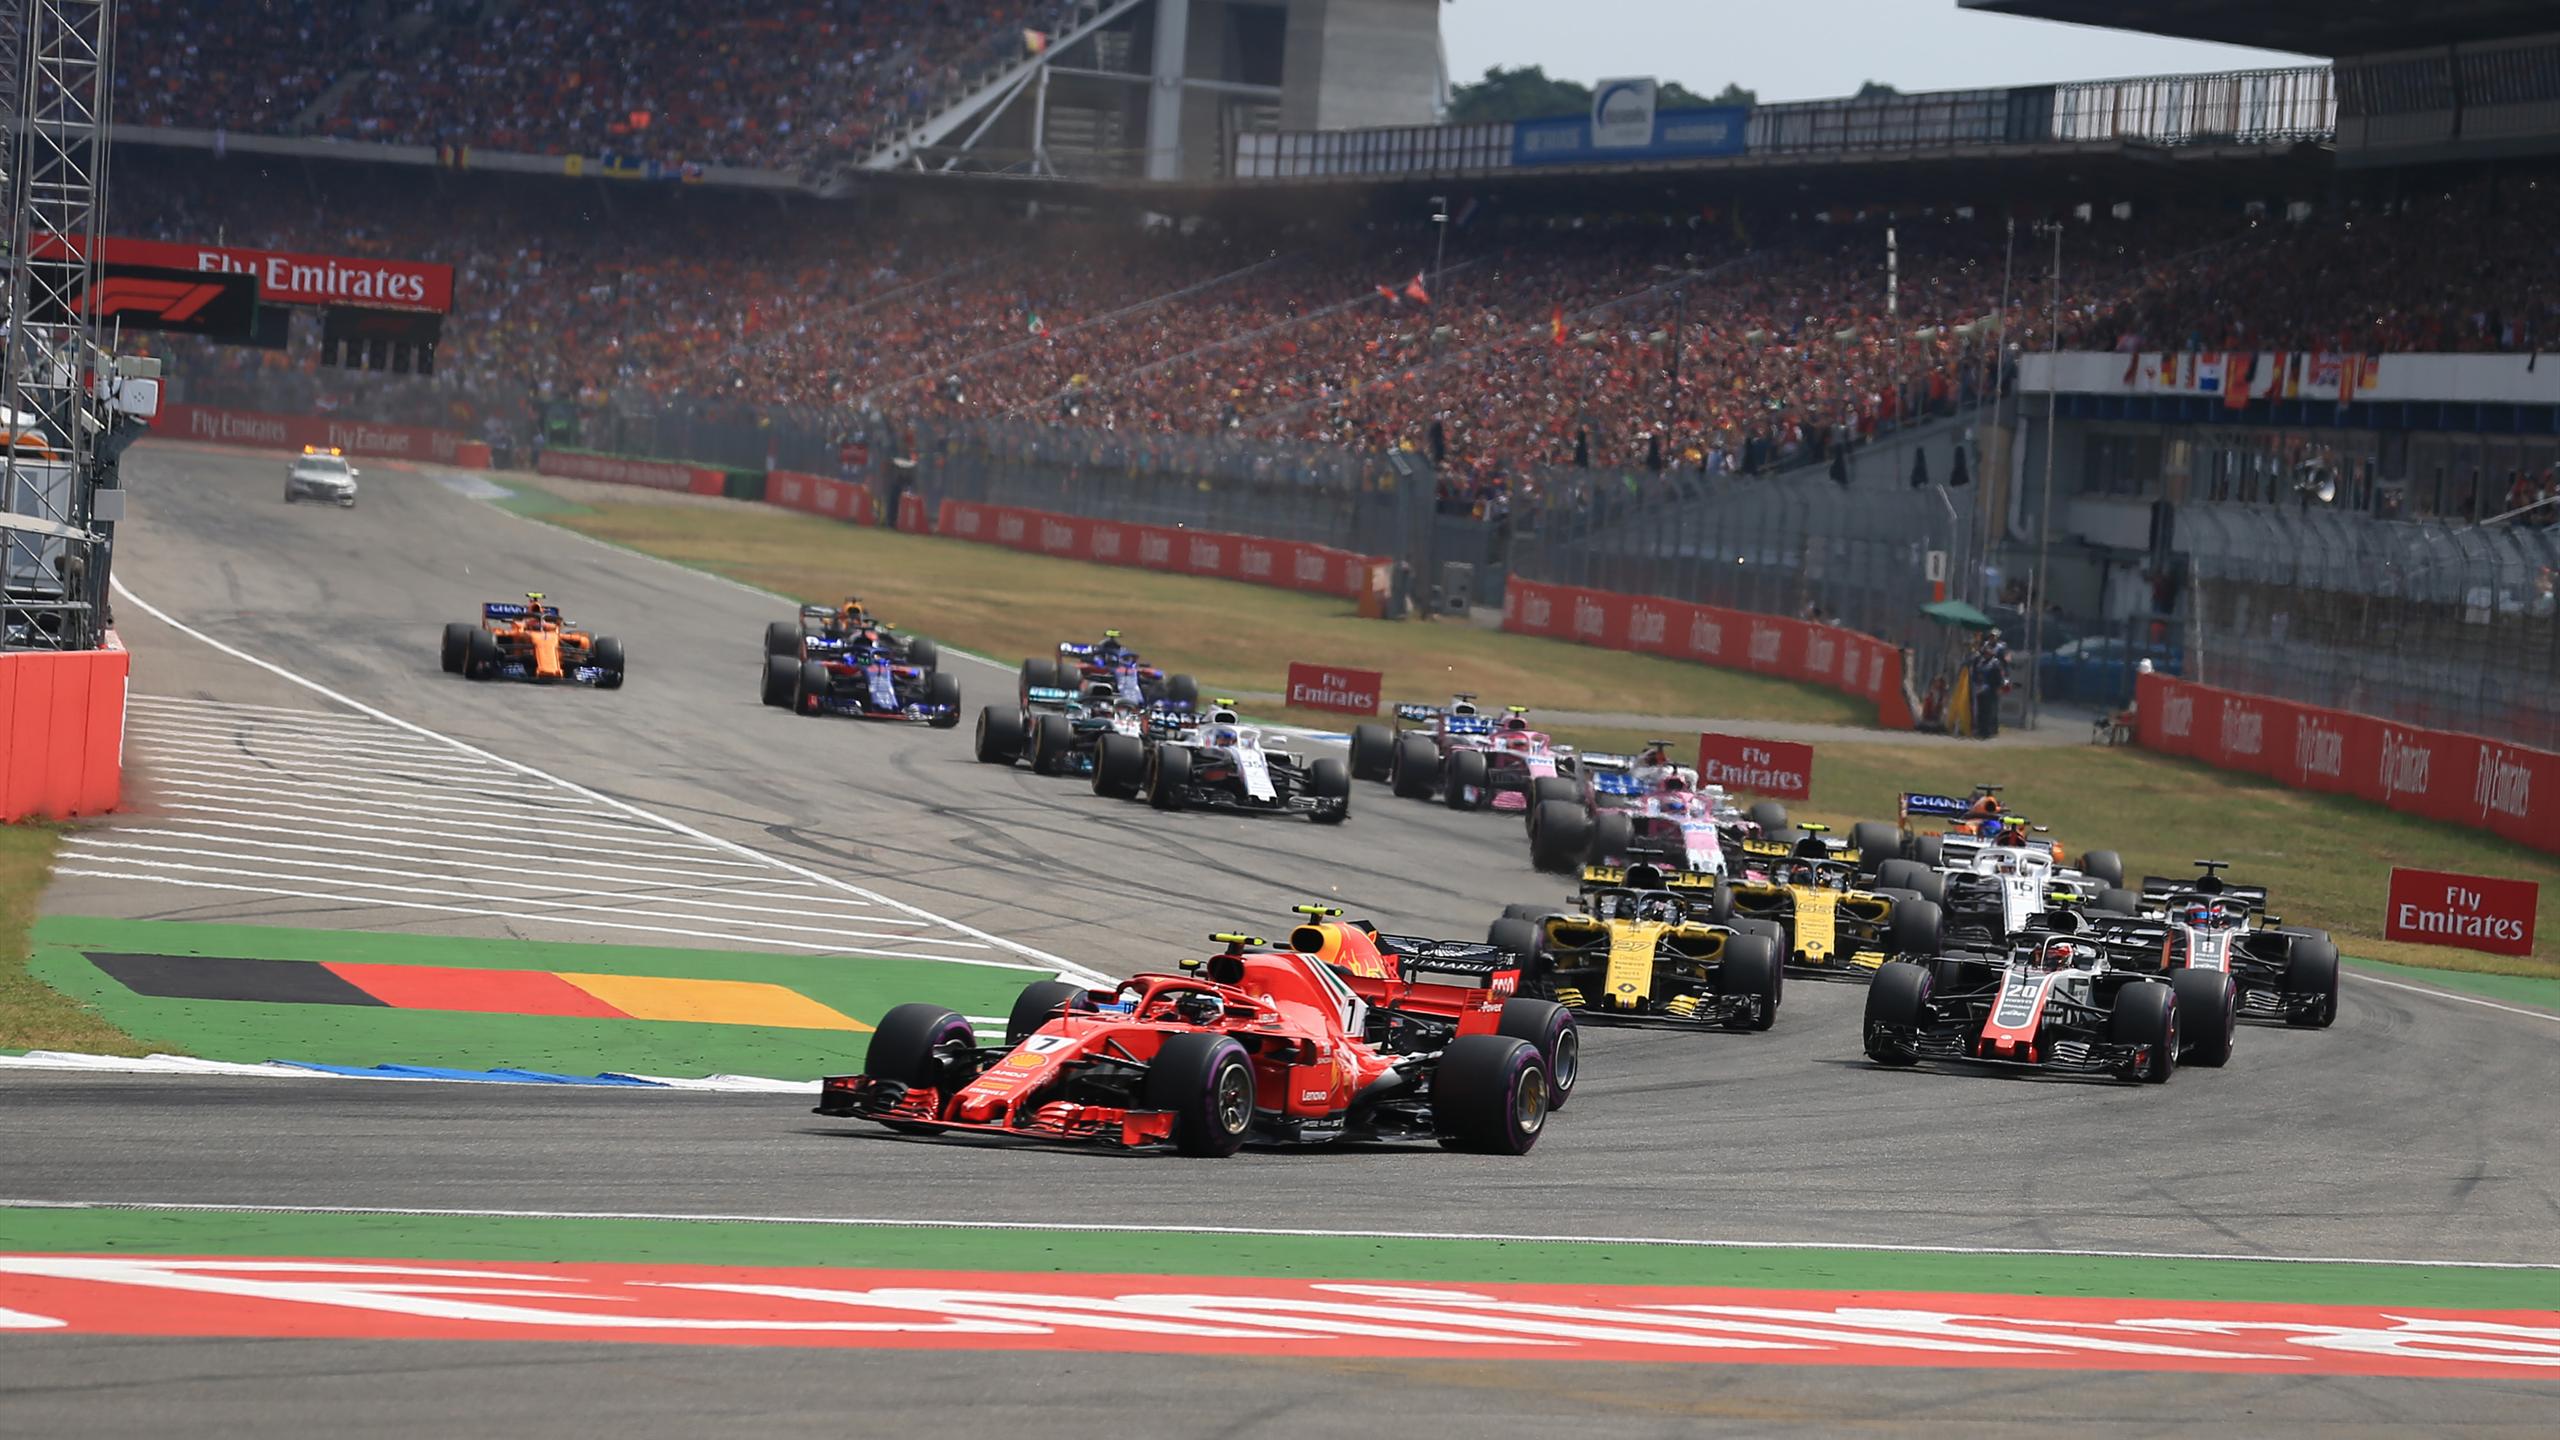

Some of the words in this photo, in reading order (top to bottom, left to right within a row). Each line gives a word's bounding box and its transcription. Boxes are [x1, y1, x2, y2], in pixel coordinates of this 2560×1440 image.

[266, 257, 424, 300] Emirates
[1323, 672, 1347, 689] Fly
[1293, 683, 1373, 708] Emirates
[1742, 747, 1771, 765] Fly
[1706, 758, 1804, 790] Emirates
[2447, 886, 2481, 911] Fly
[2399, 903, 2524, 941] Emirates
[2006, 984, 2038, 998] 20
[1034, 1037, 1062, 1051] 7
[1302, 1089, 1328, 1102] Lenovo
